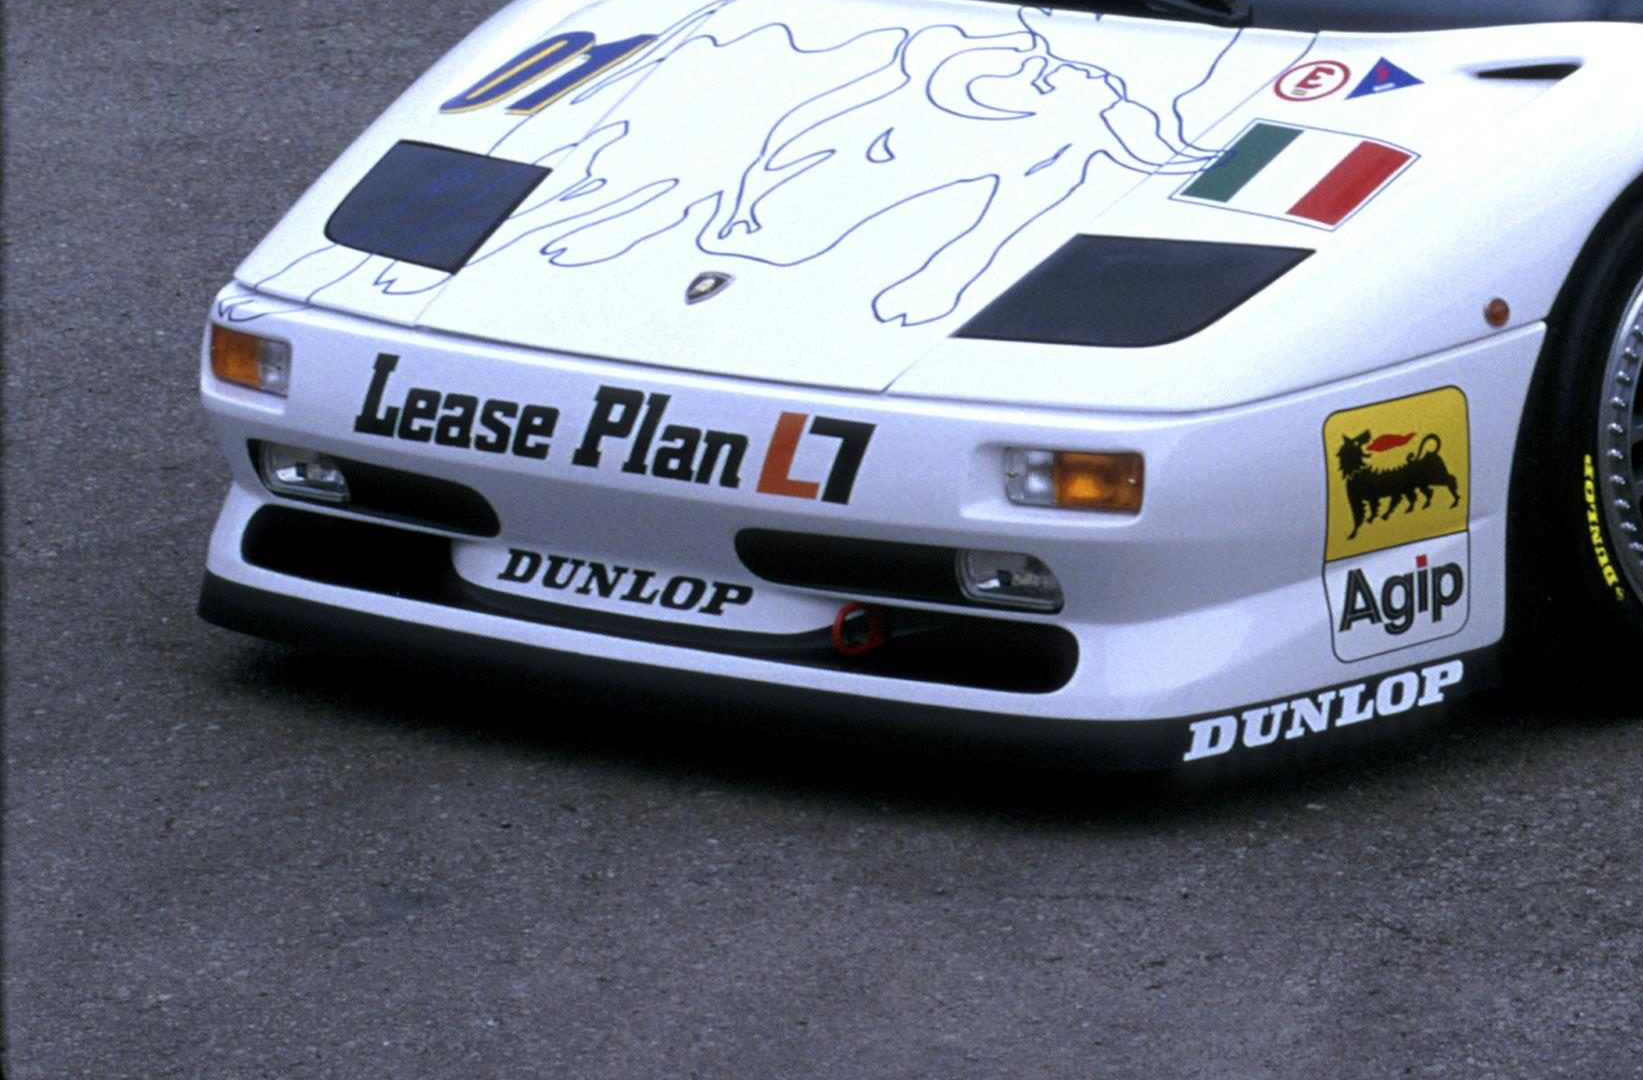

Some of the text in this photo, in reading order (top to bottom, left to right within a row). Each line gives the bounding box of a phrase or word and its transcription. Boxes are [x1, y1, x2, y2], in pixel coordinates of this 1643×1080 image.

[438, 31, 659, 116] 01
[1295, 66, 1336, 89] E
[354, 353, 560, 461] Lease
[572, 385, 750, 489] Plan
[1583, 454, 1619, 587] DUNLOP
[498, 547, 754, 616] DUNLOP
[1338, 554, 1465, 636] Agip
[1183, 658, 1465, 762] DUNLOP
